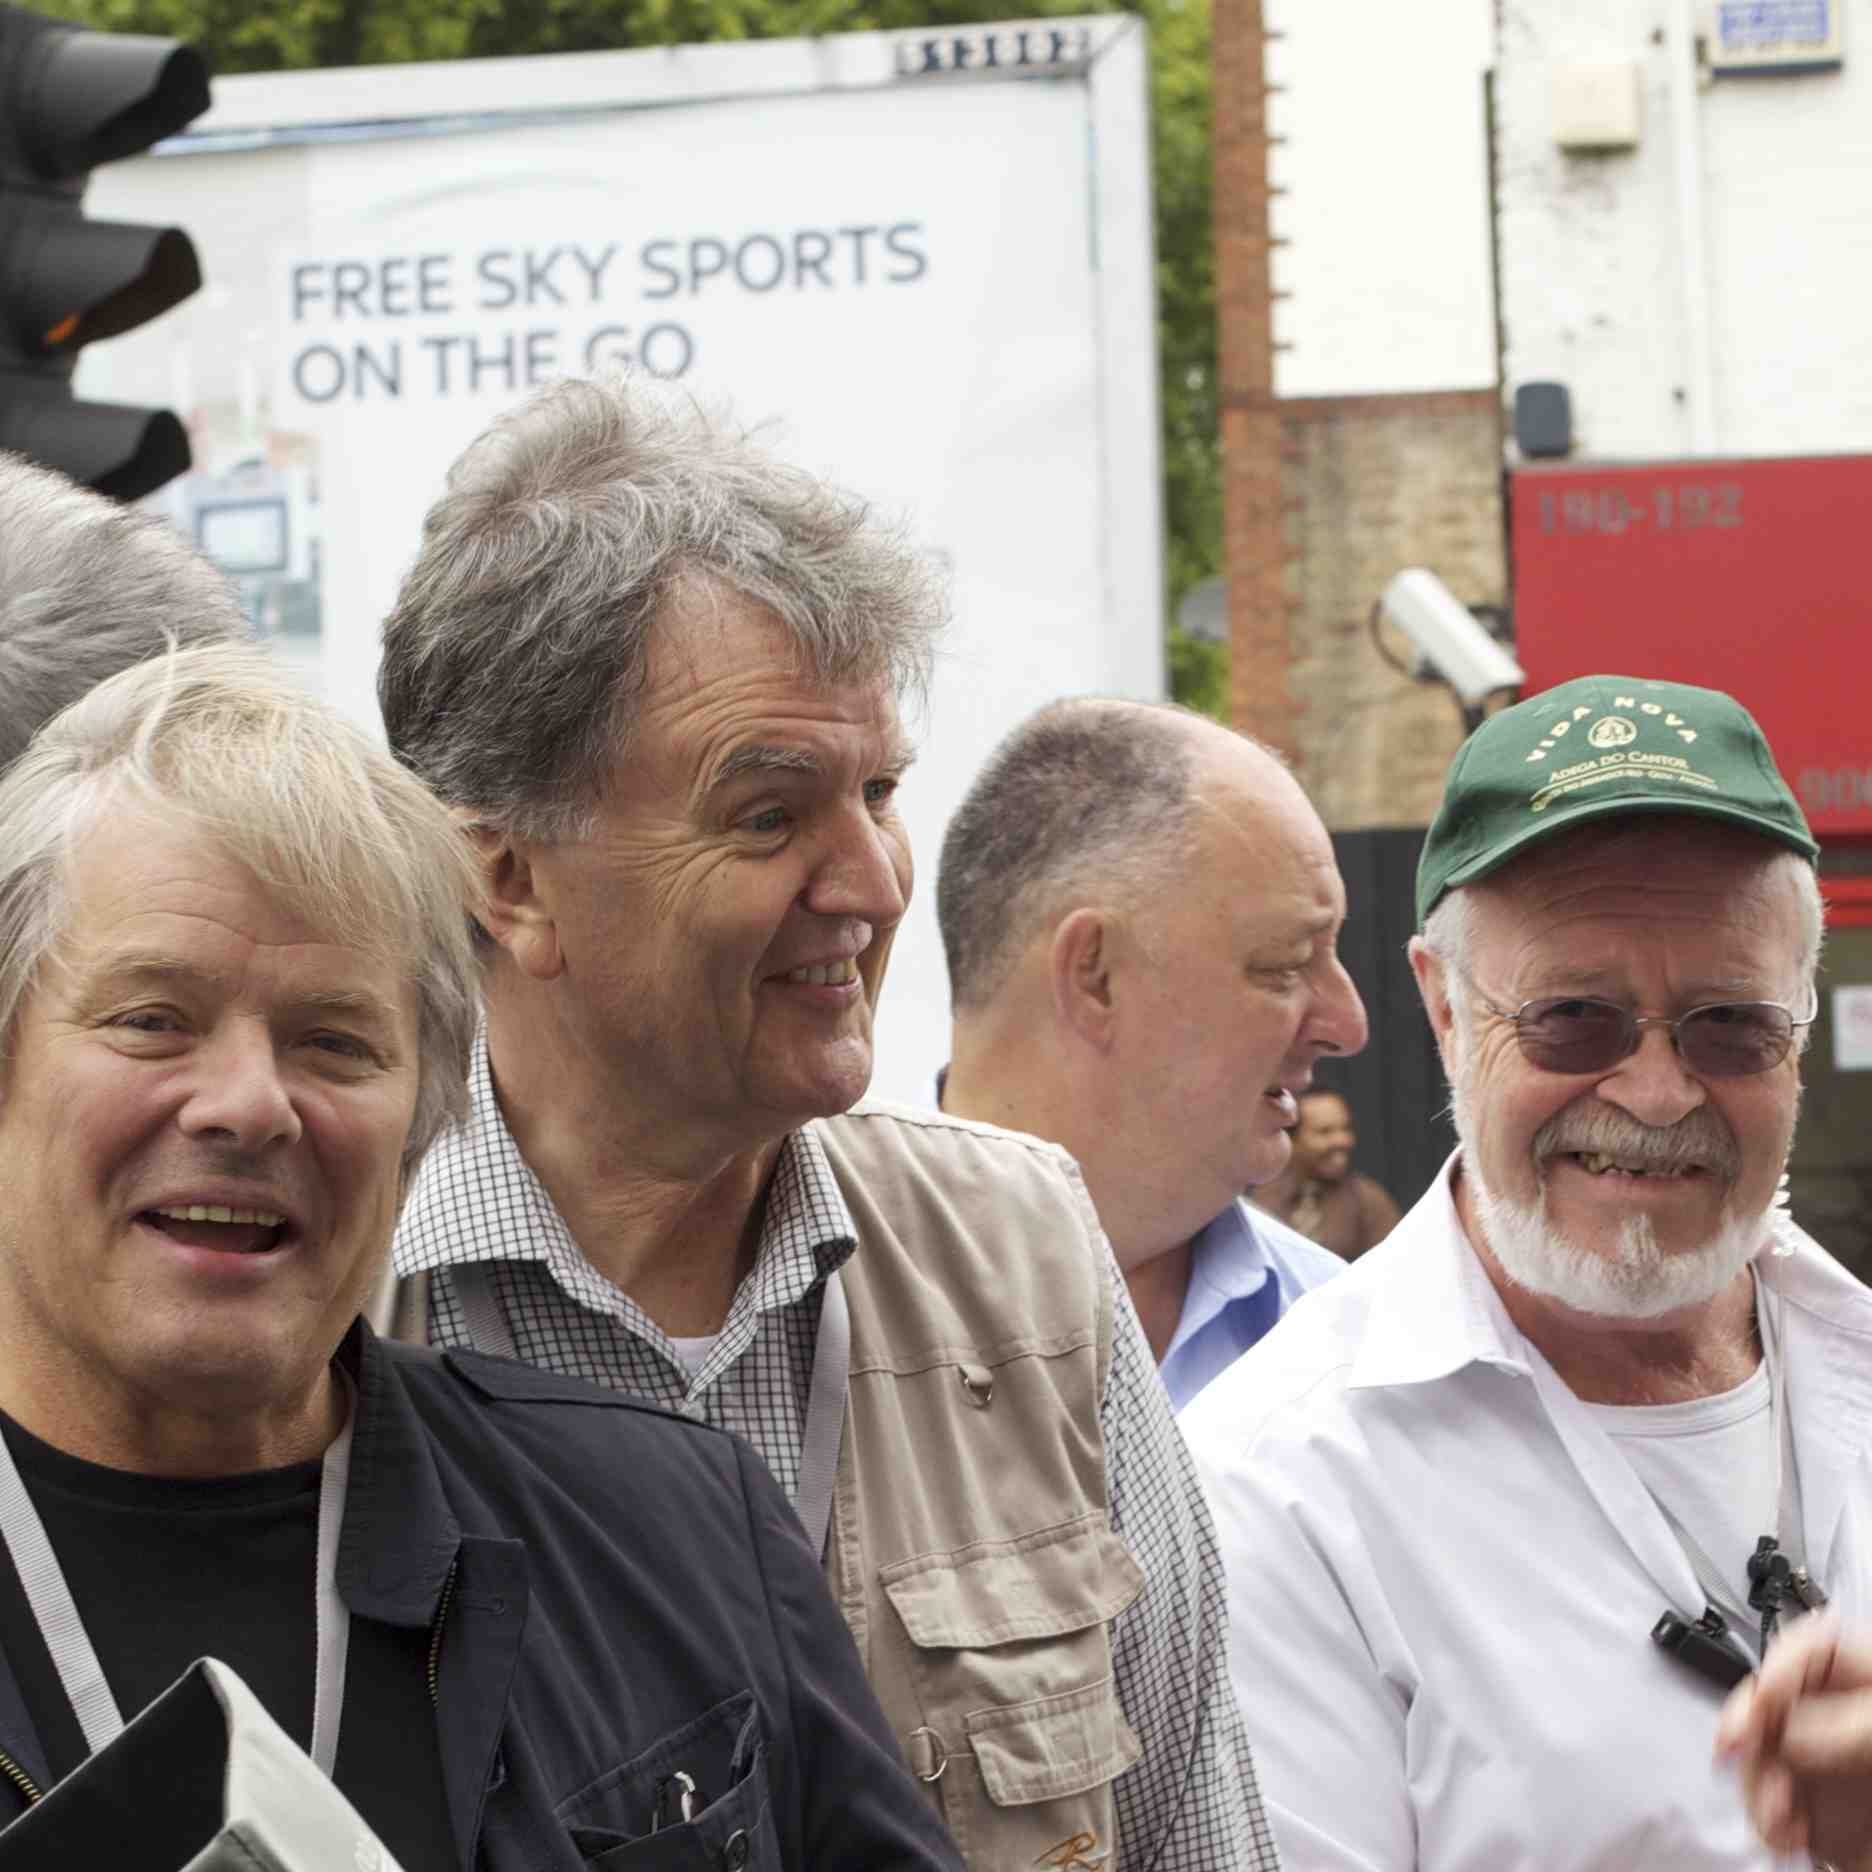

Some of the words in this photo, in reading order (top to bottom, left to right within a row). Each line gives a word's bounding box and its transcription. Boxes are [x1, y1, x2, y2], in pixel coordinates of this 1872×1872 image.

[291, 254, 452, 321] FREE
[476, 244, 618, 310] SKY
[639, 222, 930, 300] SPORTS
[291, 340, 404, 406] ON
[424, 330, 559, 394] THE
[583, 322, 695, 382] GO
[1525, 705, 1594, 764] VIDA
[1612, 695, 1699, 745] NOVA
[1548, 759, 1599, 784] ADEGA
[1599, 752, 1626, 768] DO
